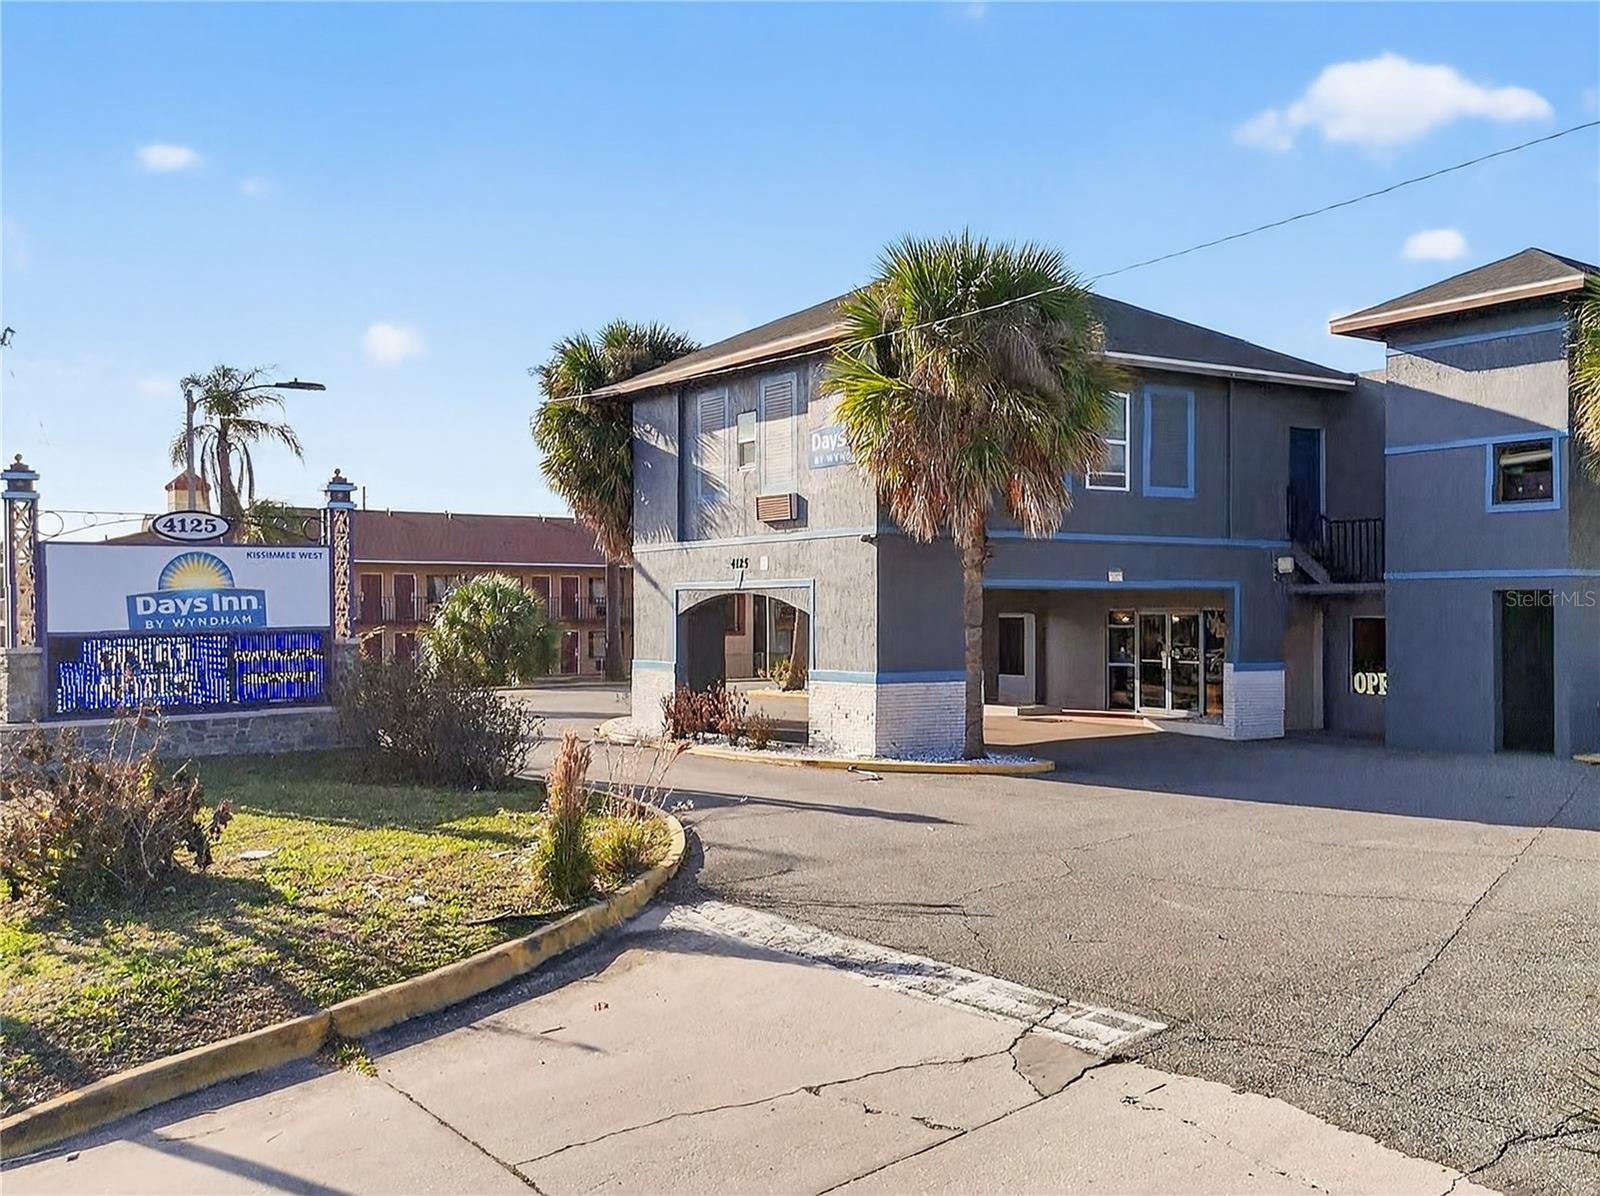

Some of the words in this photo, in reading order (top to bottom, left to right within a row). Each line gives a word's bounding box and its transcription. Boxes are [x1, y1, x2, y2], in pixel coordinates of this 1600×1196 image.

[812, 432, 847, 451] Days
[162, 517, 217, 532] 4125
[246, 551, 296, 559] KISSIMMEE
[298, 551, 323, 559] WEST
[731, 558, 749, 570] 4125
[136, 596, 208, 615] Days
[212, 593, 258, 611] Inn
[145, 619, 164, 630] BY
[172, 615, 252, 628] WYNDHAM
